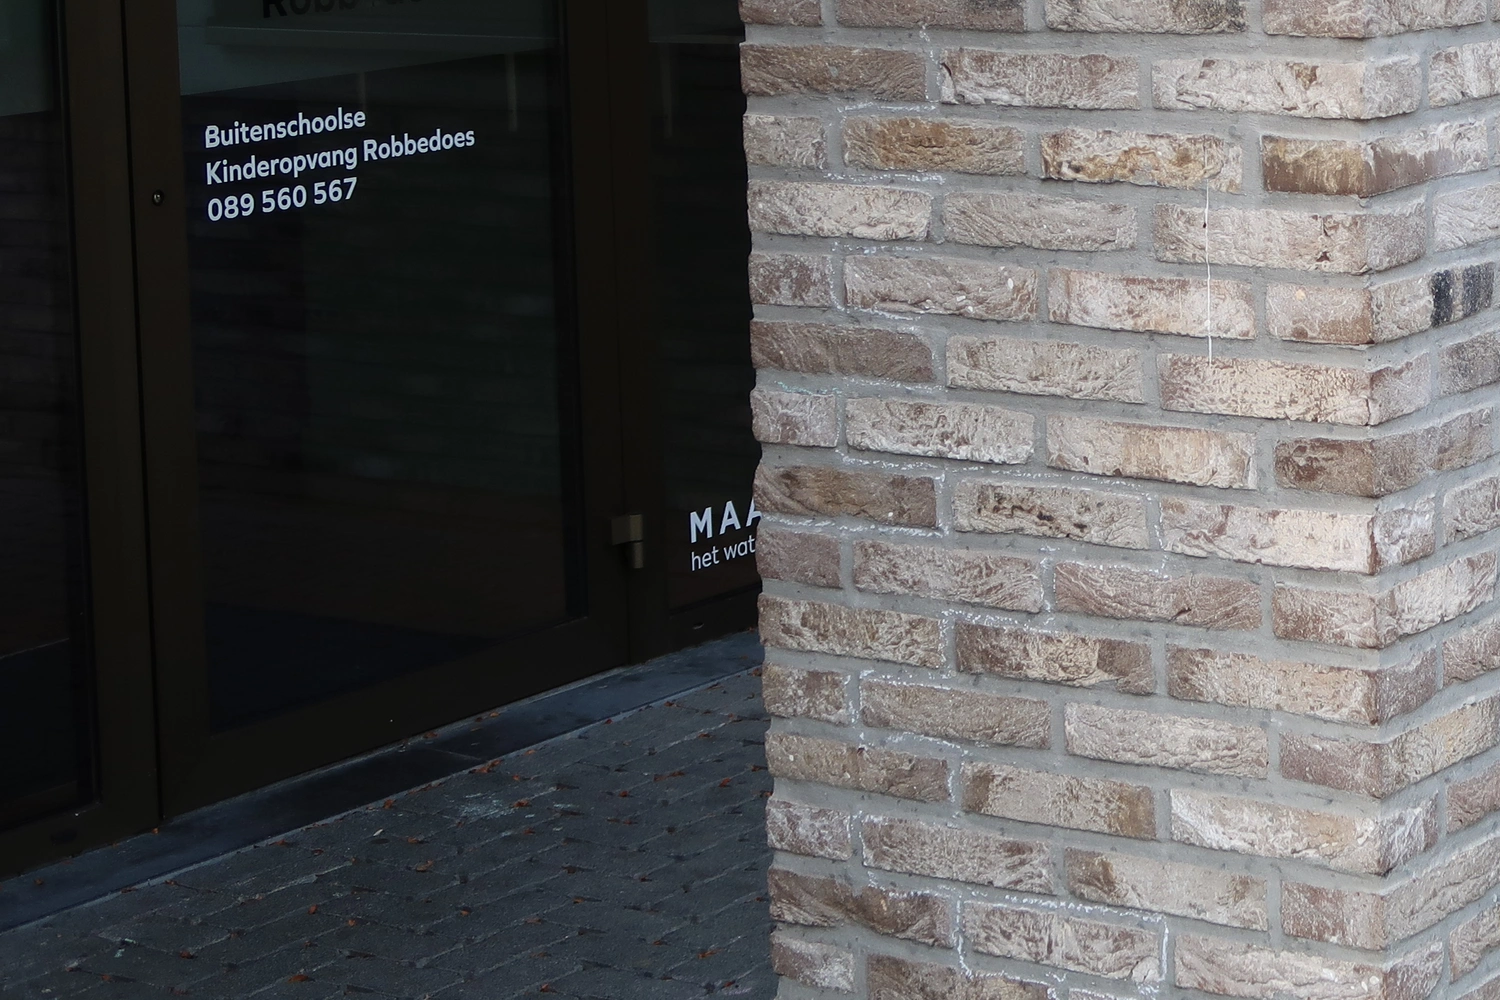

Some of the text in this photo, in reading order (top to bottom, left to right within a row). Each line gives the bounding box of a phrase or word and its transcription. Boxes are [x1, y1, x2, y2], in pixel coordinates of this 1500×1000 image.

[204, 106, 367, 149] Buitenschoolse
[205, 128, 476, 185] Kinderopvang Robbedoes
[207, 176, 358, 222] 089 560 567
[690, 545, 720, 572] het
